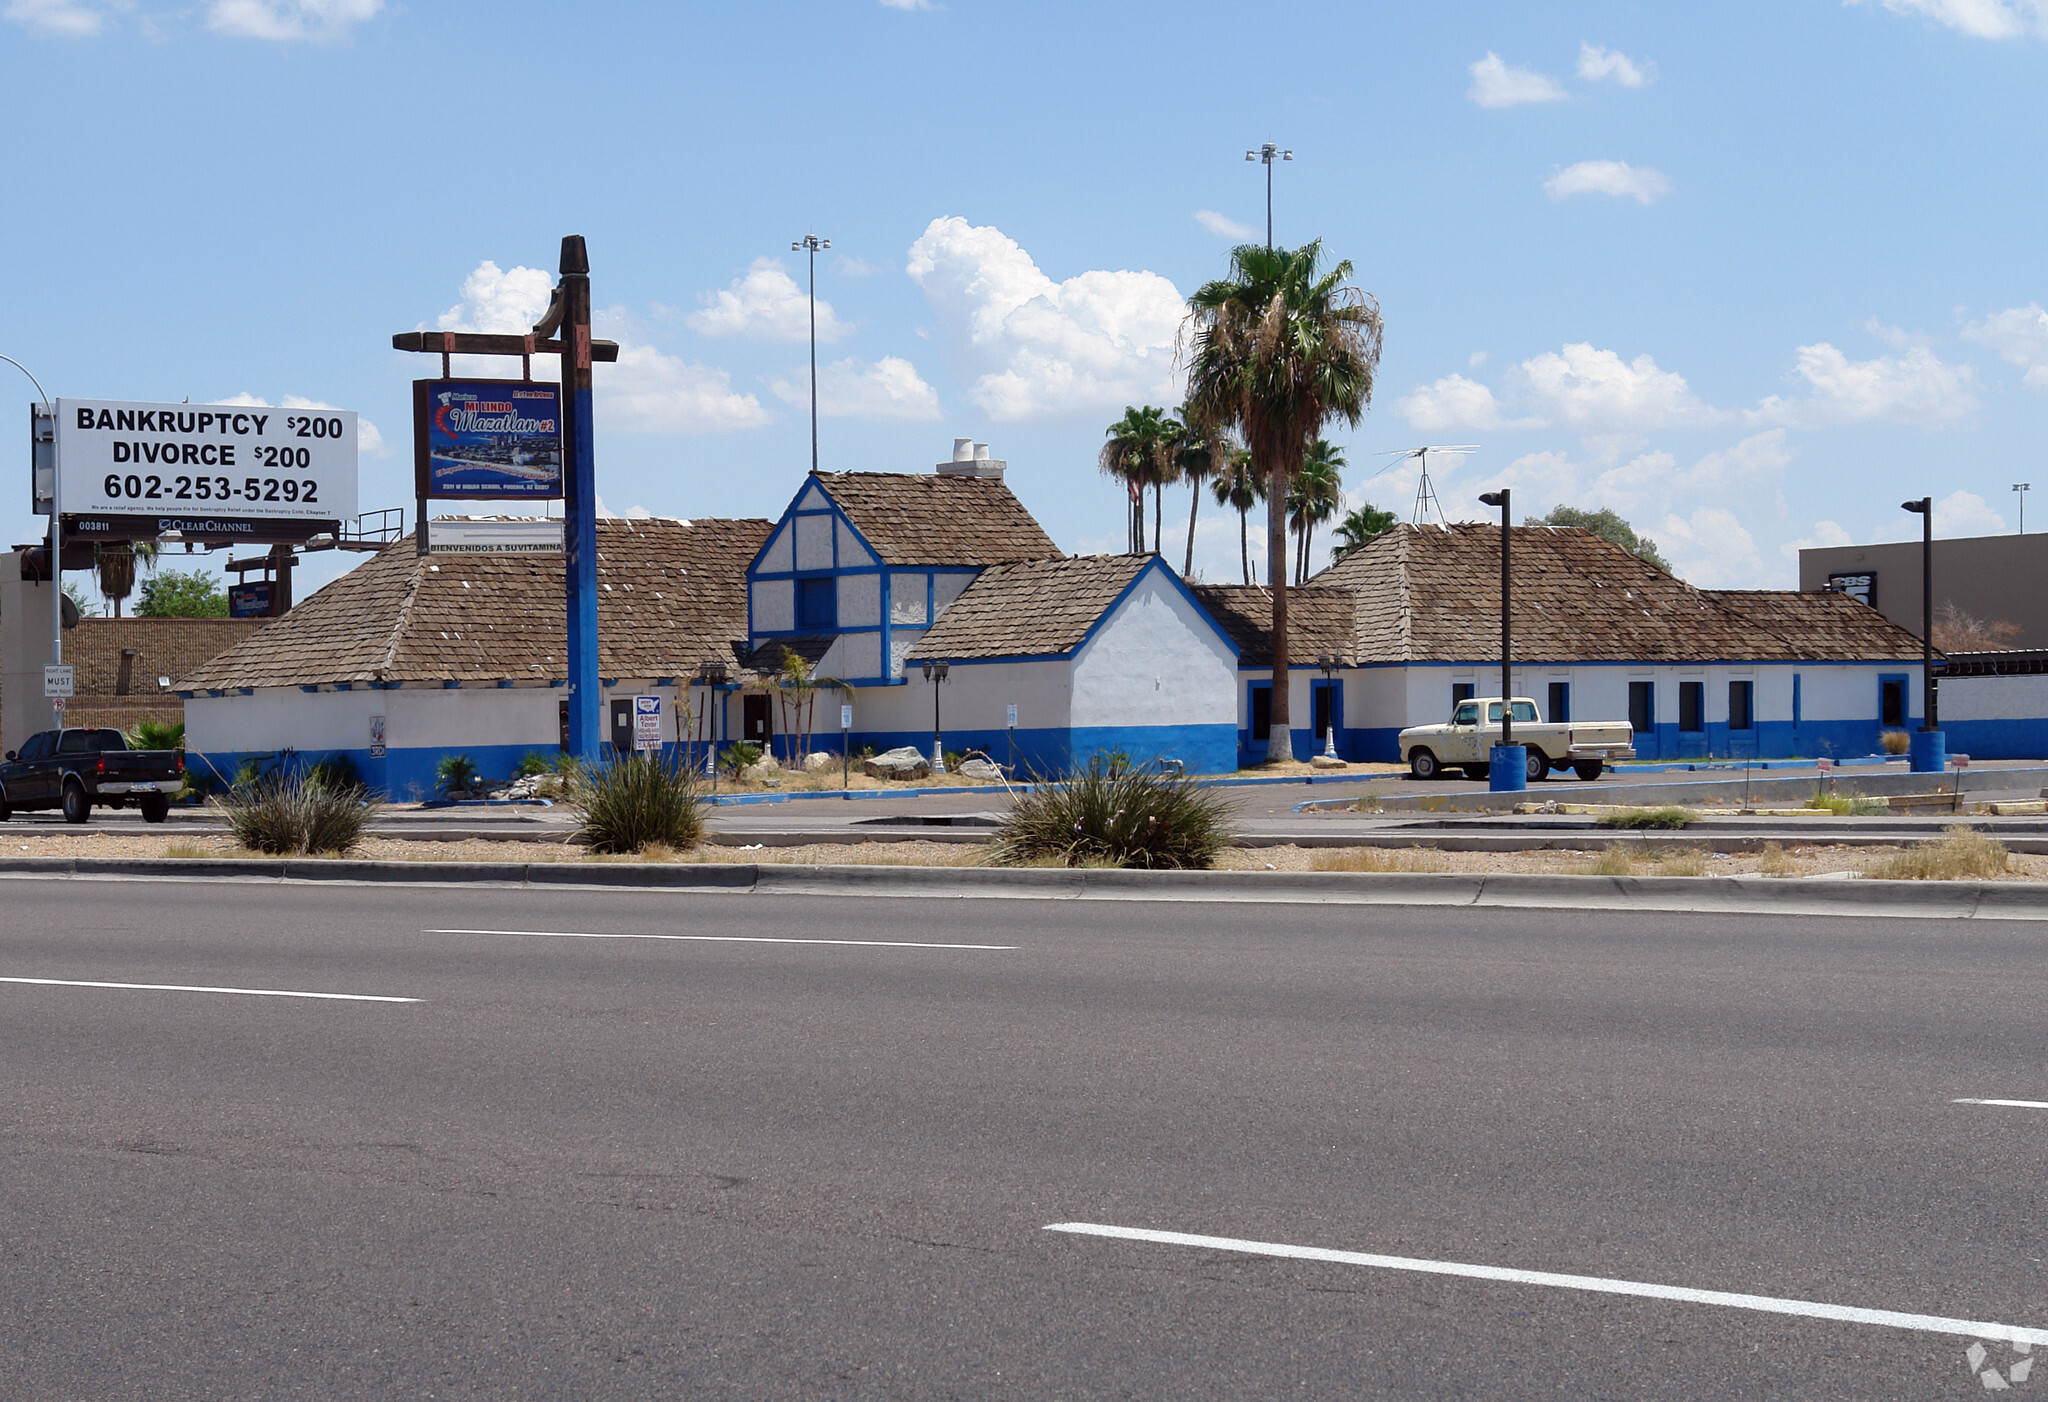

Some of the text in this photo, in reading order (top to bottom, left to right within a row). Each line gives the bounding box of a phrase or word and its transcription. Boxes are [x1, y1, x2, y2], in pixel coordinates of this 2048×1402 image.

[464, 402, 512, 413] MI LINDO
[77, 408, 343, 439] BANKRUPTCY $200
[450, 409, 554, 432] Mazatlan #2
[113, 442, 310, 468] DIVORCE $200
[104, 474, 318, 503] 602-253-5292
[79, 521, 110, 532] 003811
